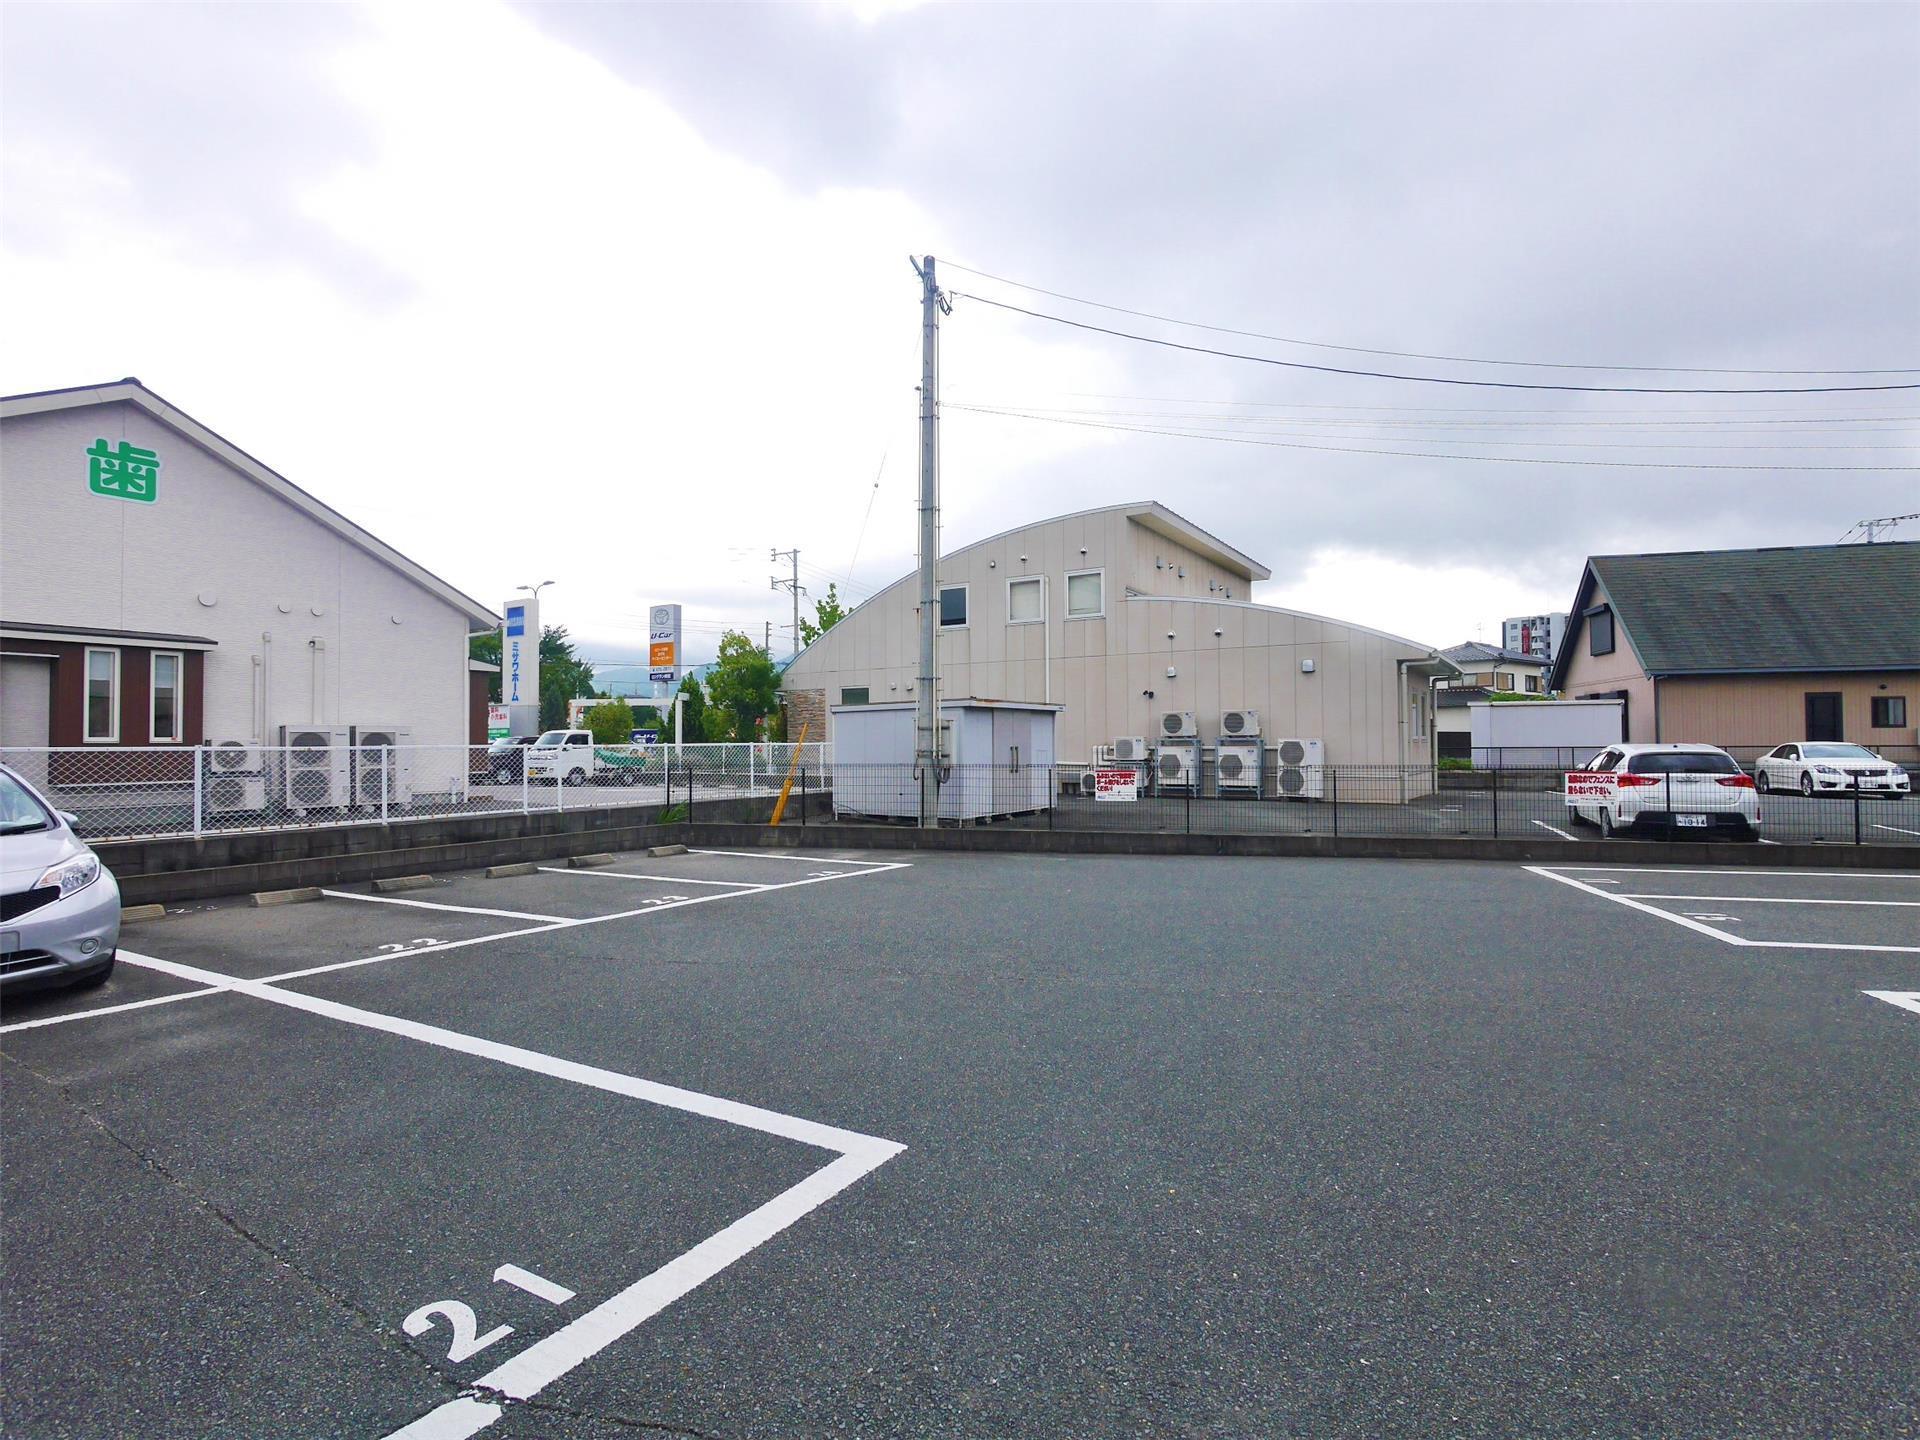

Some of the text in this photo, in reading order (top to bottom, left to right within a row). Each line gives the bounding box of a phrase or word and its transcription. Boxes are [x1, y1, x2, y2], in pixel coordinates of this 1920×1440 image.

[87, 438, 160, 502] 歯
[651, 632, 673, 640] U-Car
[511, 641, 520, 702] ミサワホーム
[378, 937, 449, 952] 22
[402, 1263, 577, 1364] 21
